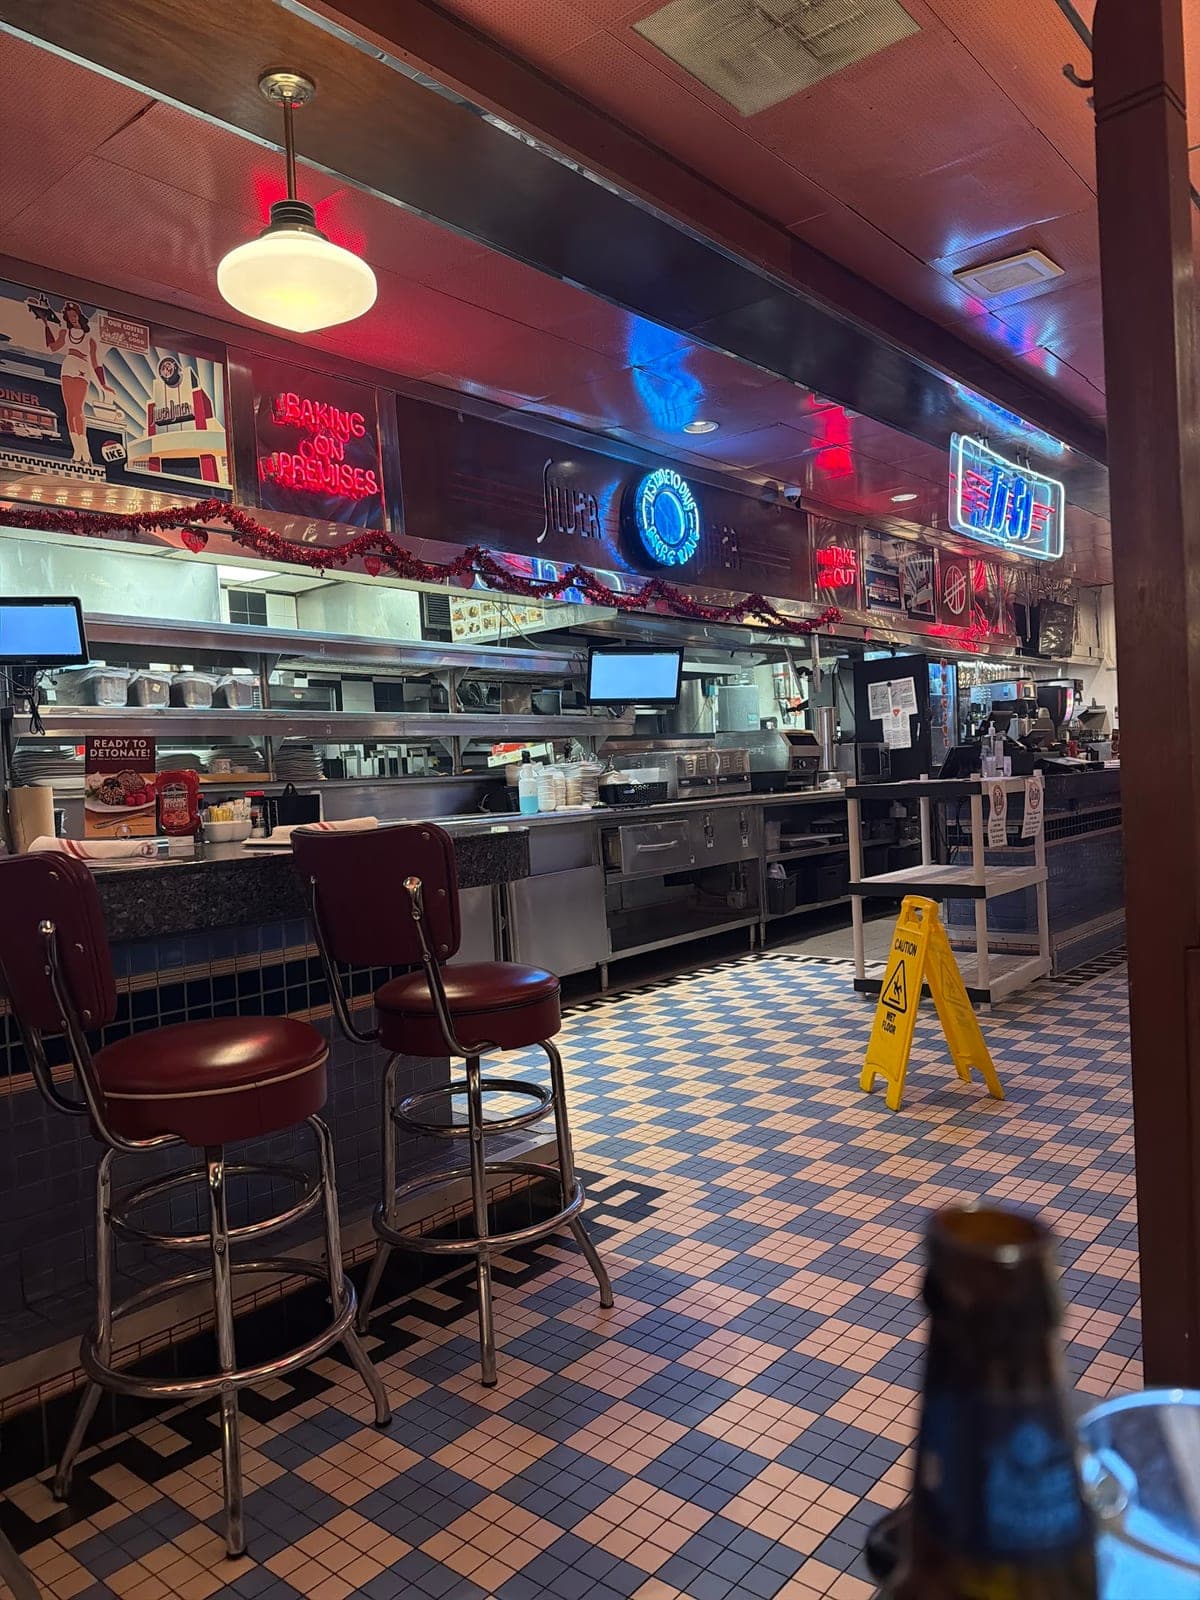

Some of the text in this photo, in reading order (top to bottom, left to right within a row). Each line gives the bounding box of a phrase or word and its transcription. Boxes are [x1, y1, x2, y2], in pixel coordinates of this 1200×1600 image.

[284, 392, 367, 438] BAKING
[104, 449, 124, 461] IKE
[313, 434, 345, 461] ON
[279, 451, 378, 495] PREMISES
[831, 546, 855, 566] TAKE
[833, 568, 856, 585] OUT
[94, 739, 147, 748] READY TO
[90, 748, 151, 757] DETONATE!
[894, 938, 918, 957] CAUTION
[886, 1011, 897, 1023] WET
[881, 1020, 897, 1035] FLOOR
